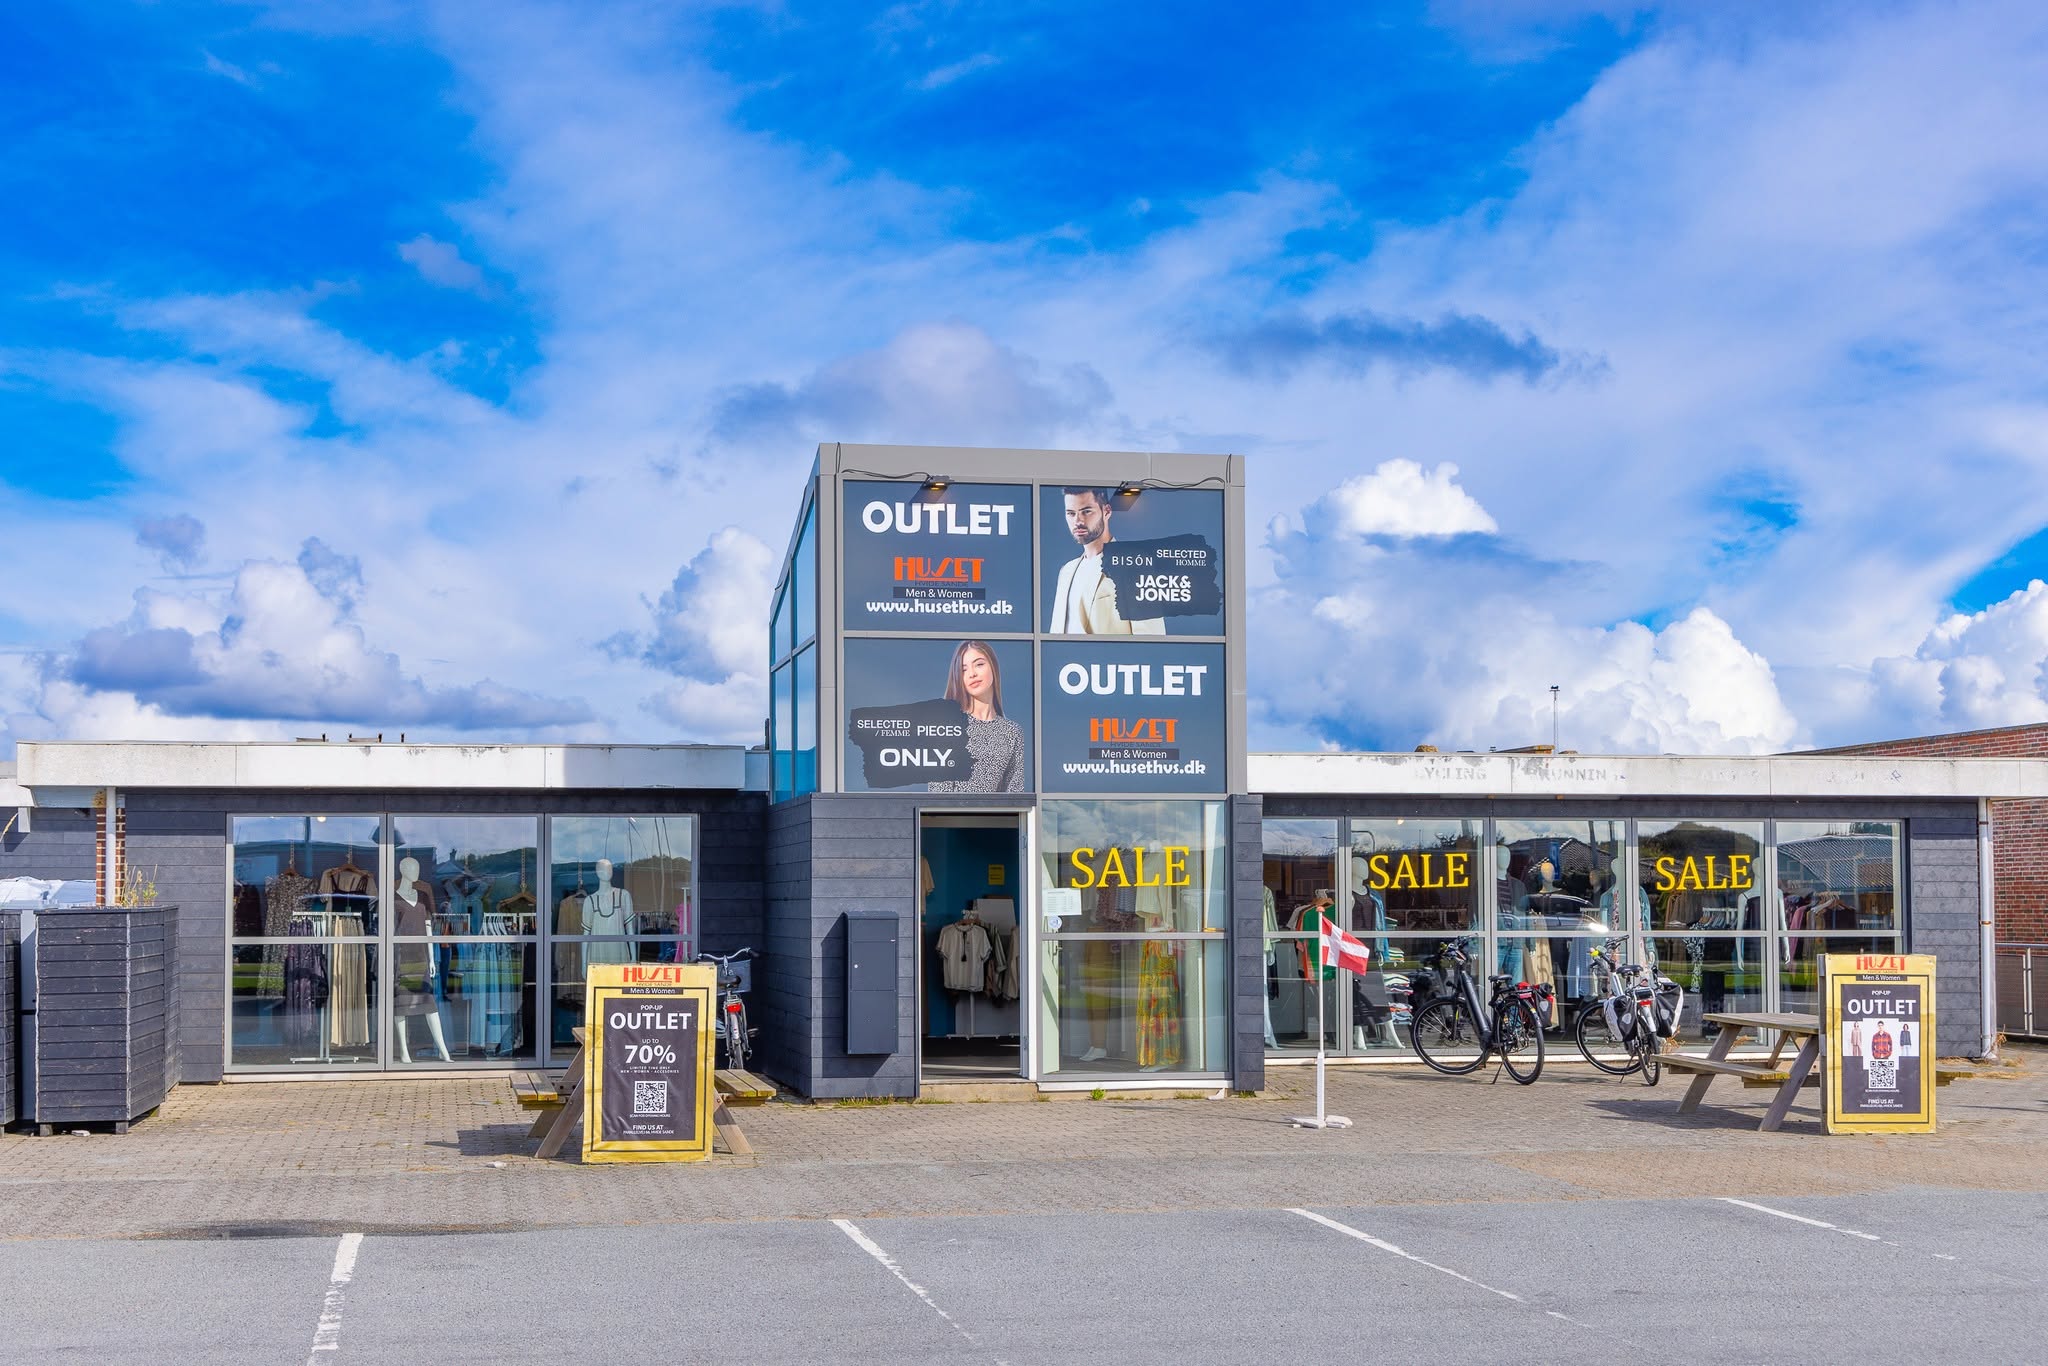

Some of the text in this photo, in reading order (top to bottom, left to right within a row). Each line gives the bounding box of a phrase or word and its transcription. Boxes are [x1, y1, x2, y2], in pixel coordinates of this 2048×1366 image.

[862, 500, 1015, 536] OUTLET
[1112, 554, 1153, 566] BISÓN
[1156, 549, 1207, 559] SELECTED
[894, 556, 985, 583] HUSET
[1175, 559, 1207, 567] HOMME
[1135, 574, 1192, 589] JACK&
[905, 588, 973, 599] Men & Women
[1135, 588, 1192, 602] JONES
[866, 599, 1013, 615] www.husethvs.dk
[1058, 663, 1208, 696] OUTLET
[857, 719, 911, 729] SELECTED
[917, 725, 962, 737] PIECES
[1090, 717, 1179, 743] HUSET
[881, 729, 911, 737] FEMME
[879, 748, 953, 768] ONLY
[1101, 749, 1167, 759] Men & Women
[1063, 759, 1206, 775] www.husethvs.dk
[1071, 845, 1191, 889] SALE
[1369, 853, 1469, 889] SALE
[1655, 854, 1752, 892] SALE
[1856, 956, 1906, 971] HUSET
[623, 967, 683, 983] HUSET
[1847, 999, 1917, 1015] OUTLET
[609, 1012, 692, 1030] OUTLET
[624, 1044, 677, 1064] 70%
